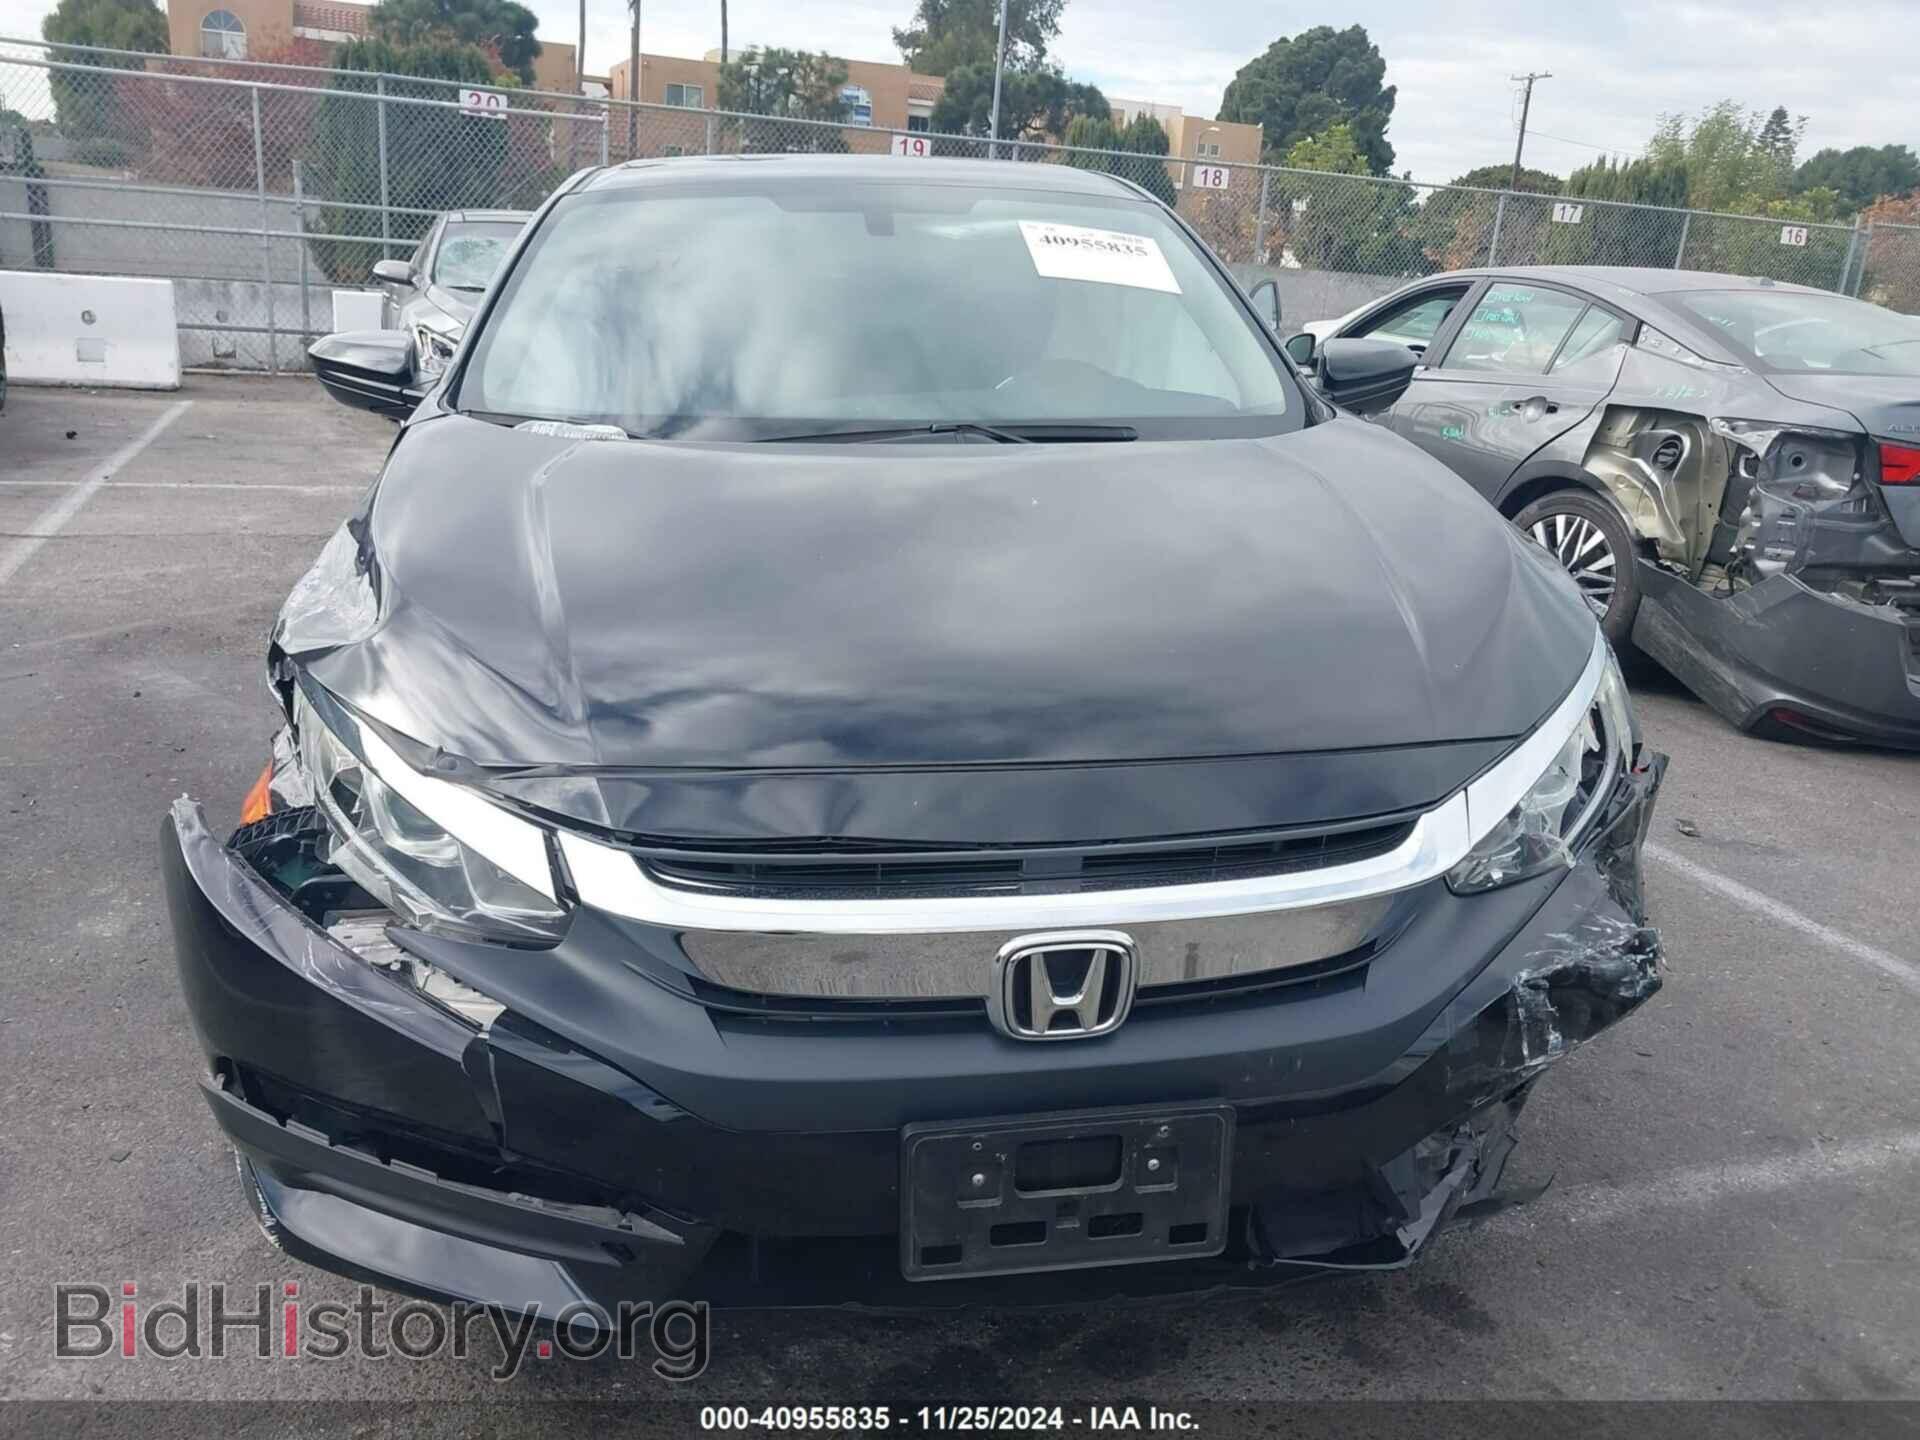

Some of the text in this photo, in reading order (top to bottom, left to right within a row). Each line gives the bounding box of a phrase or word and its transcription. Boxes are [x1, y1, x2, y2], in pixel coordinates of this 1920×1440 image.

[900, 137, 925, 156] 19
[1201, 168, 1223, 187] 18
[1560, 205, 1578, 221] 17
[1040, 234, 1148, 257] 40955835
[1787, 228, 1802, 244] 16
